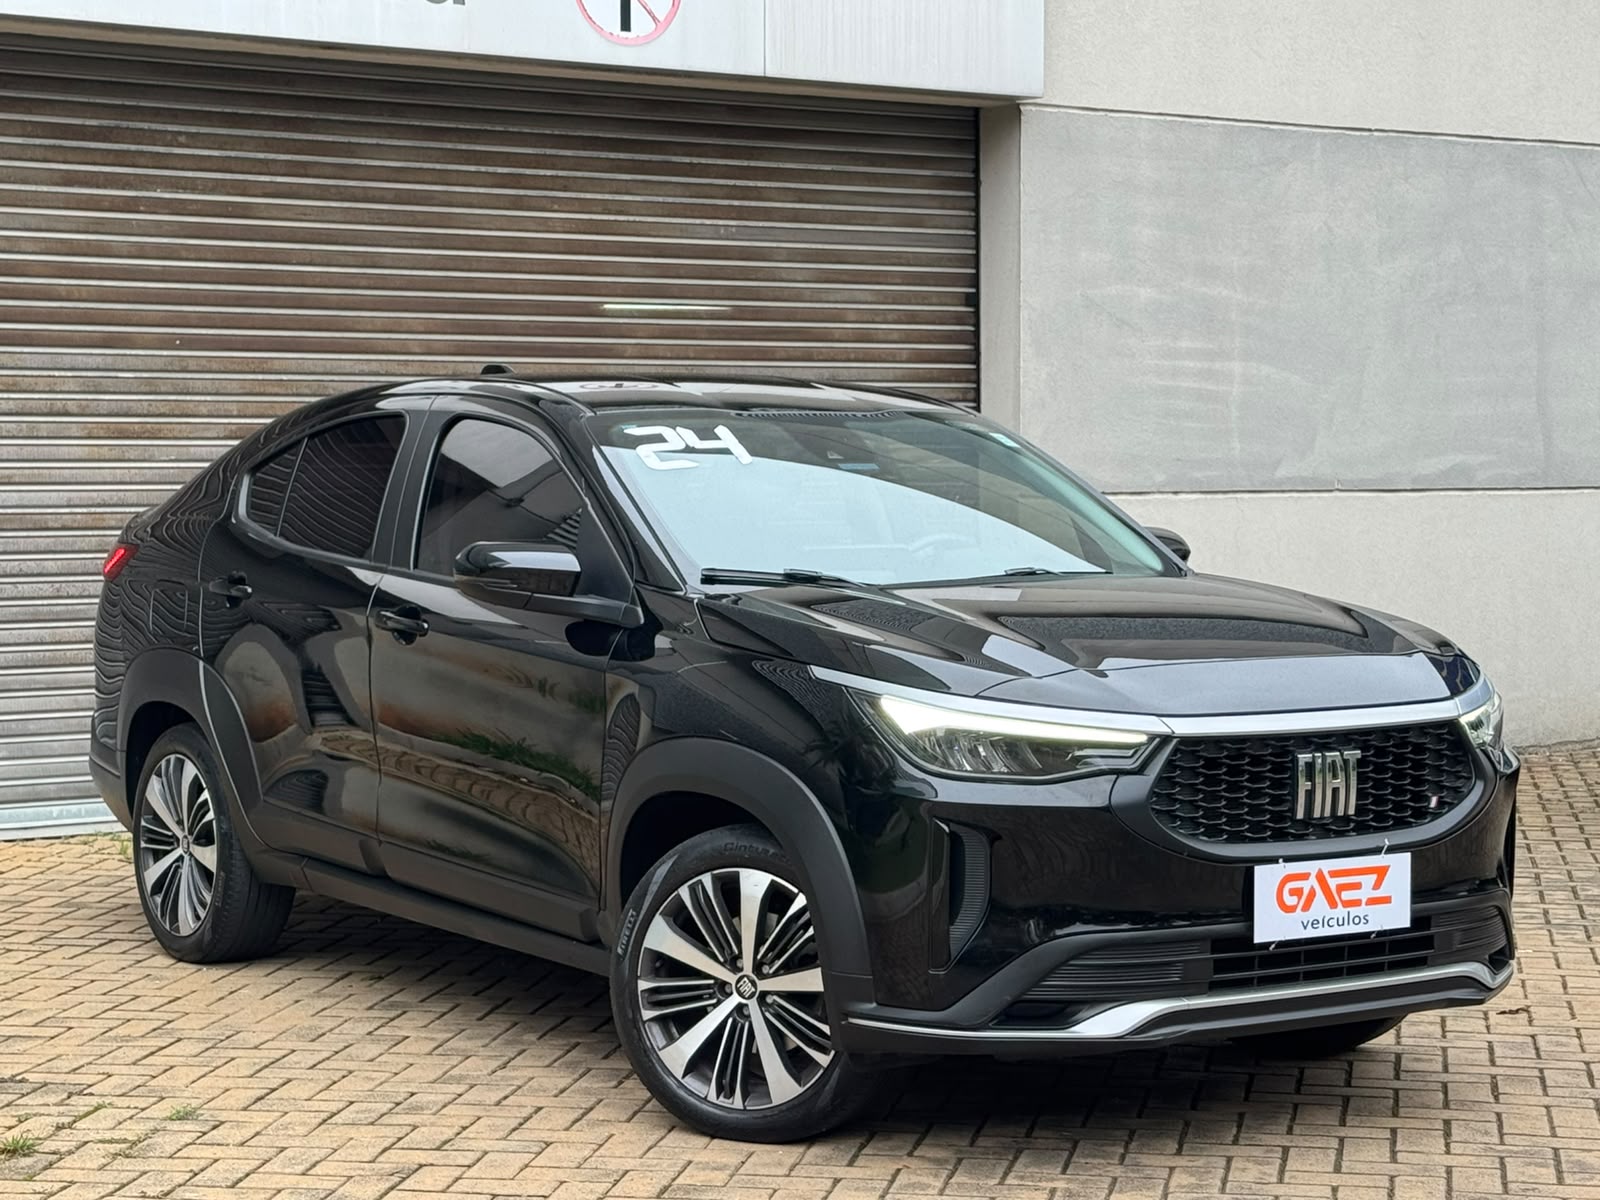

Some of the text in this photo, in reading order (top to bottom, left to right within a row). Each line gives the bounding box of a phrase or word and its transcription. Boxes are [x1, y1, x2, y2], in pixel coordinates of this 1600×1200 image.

[623, 424, 753, 471] 24
[1295, 750, 1362, 820] FIAT
[1276, 865, 1392, 914] GAEZ
[1301, 911, 1369, 930] veículos
